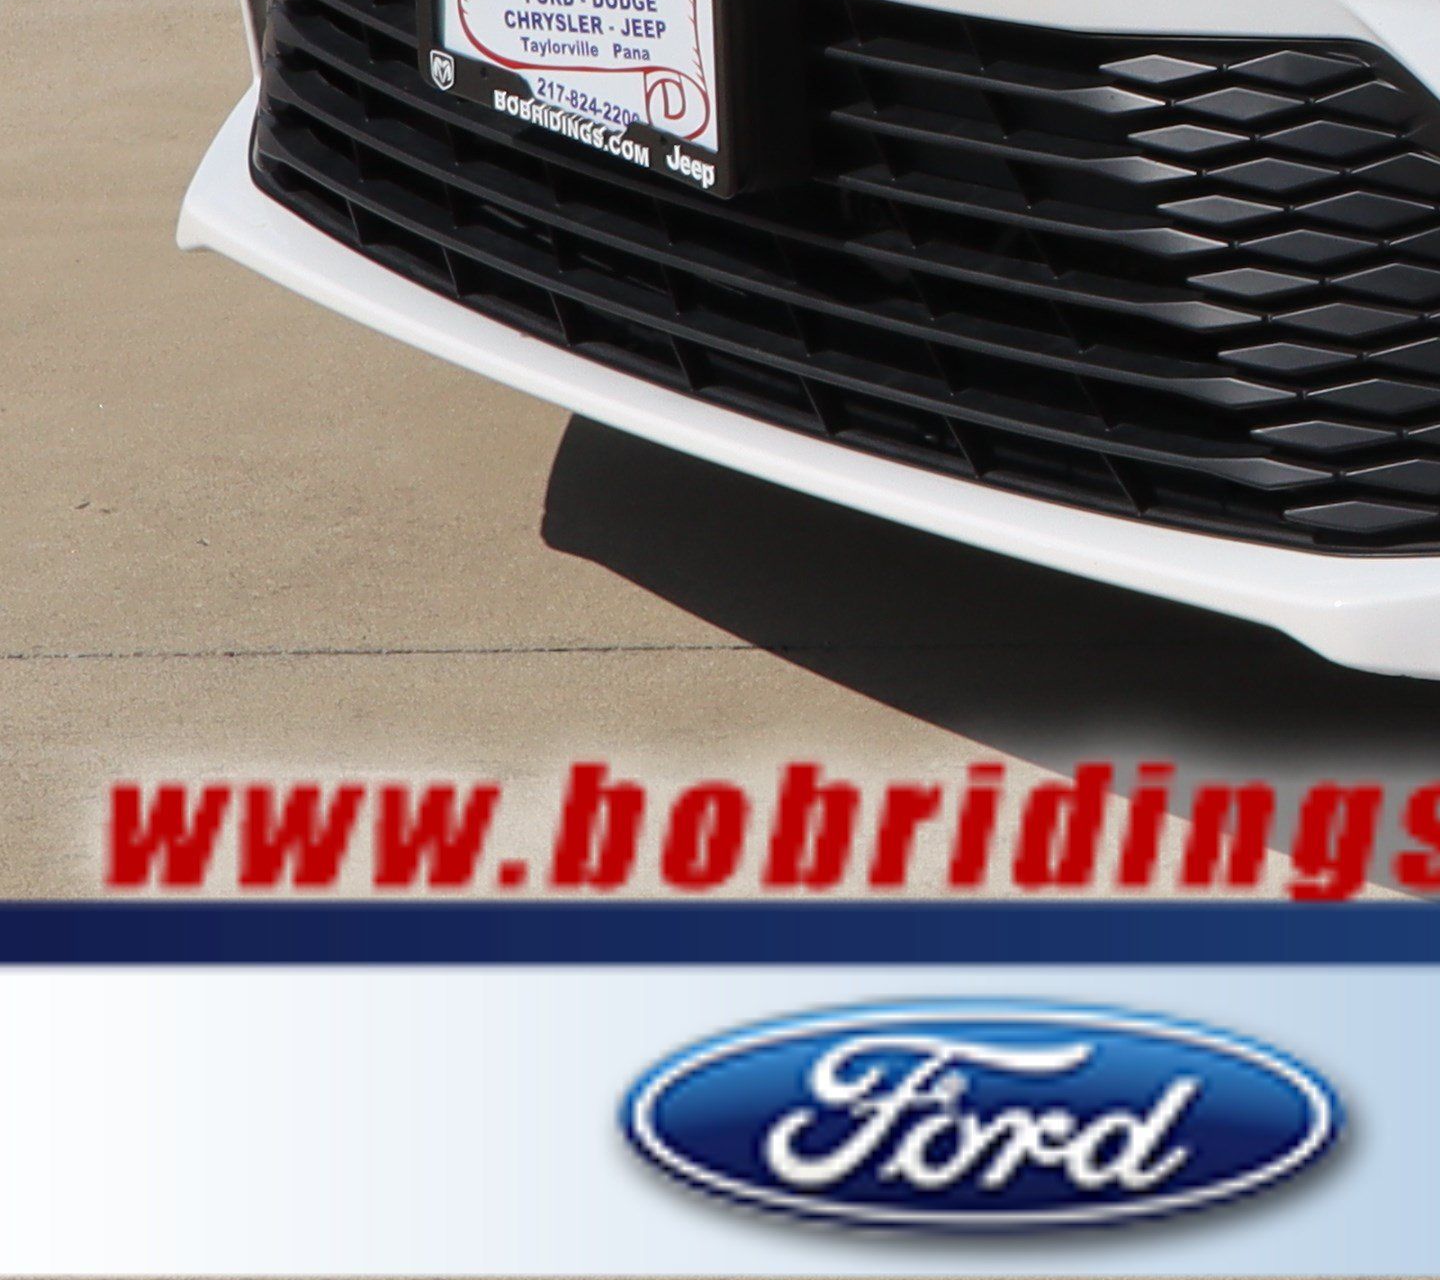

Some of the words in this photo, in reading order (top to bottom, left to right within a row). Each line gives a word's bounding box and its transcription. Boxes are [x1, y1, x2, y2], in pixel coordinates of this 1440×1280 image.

[504, 9, 604, 36] CHRYSLER
[620, 17, 667, 39] JEEP
[520, 36, 600, 58] Taylorville
[612, 42, 651, 61] Pana
[493, 89, 651, 168] BOBRIDINGS.COM
[665, 144, 716, 189] Jeep
